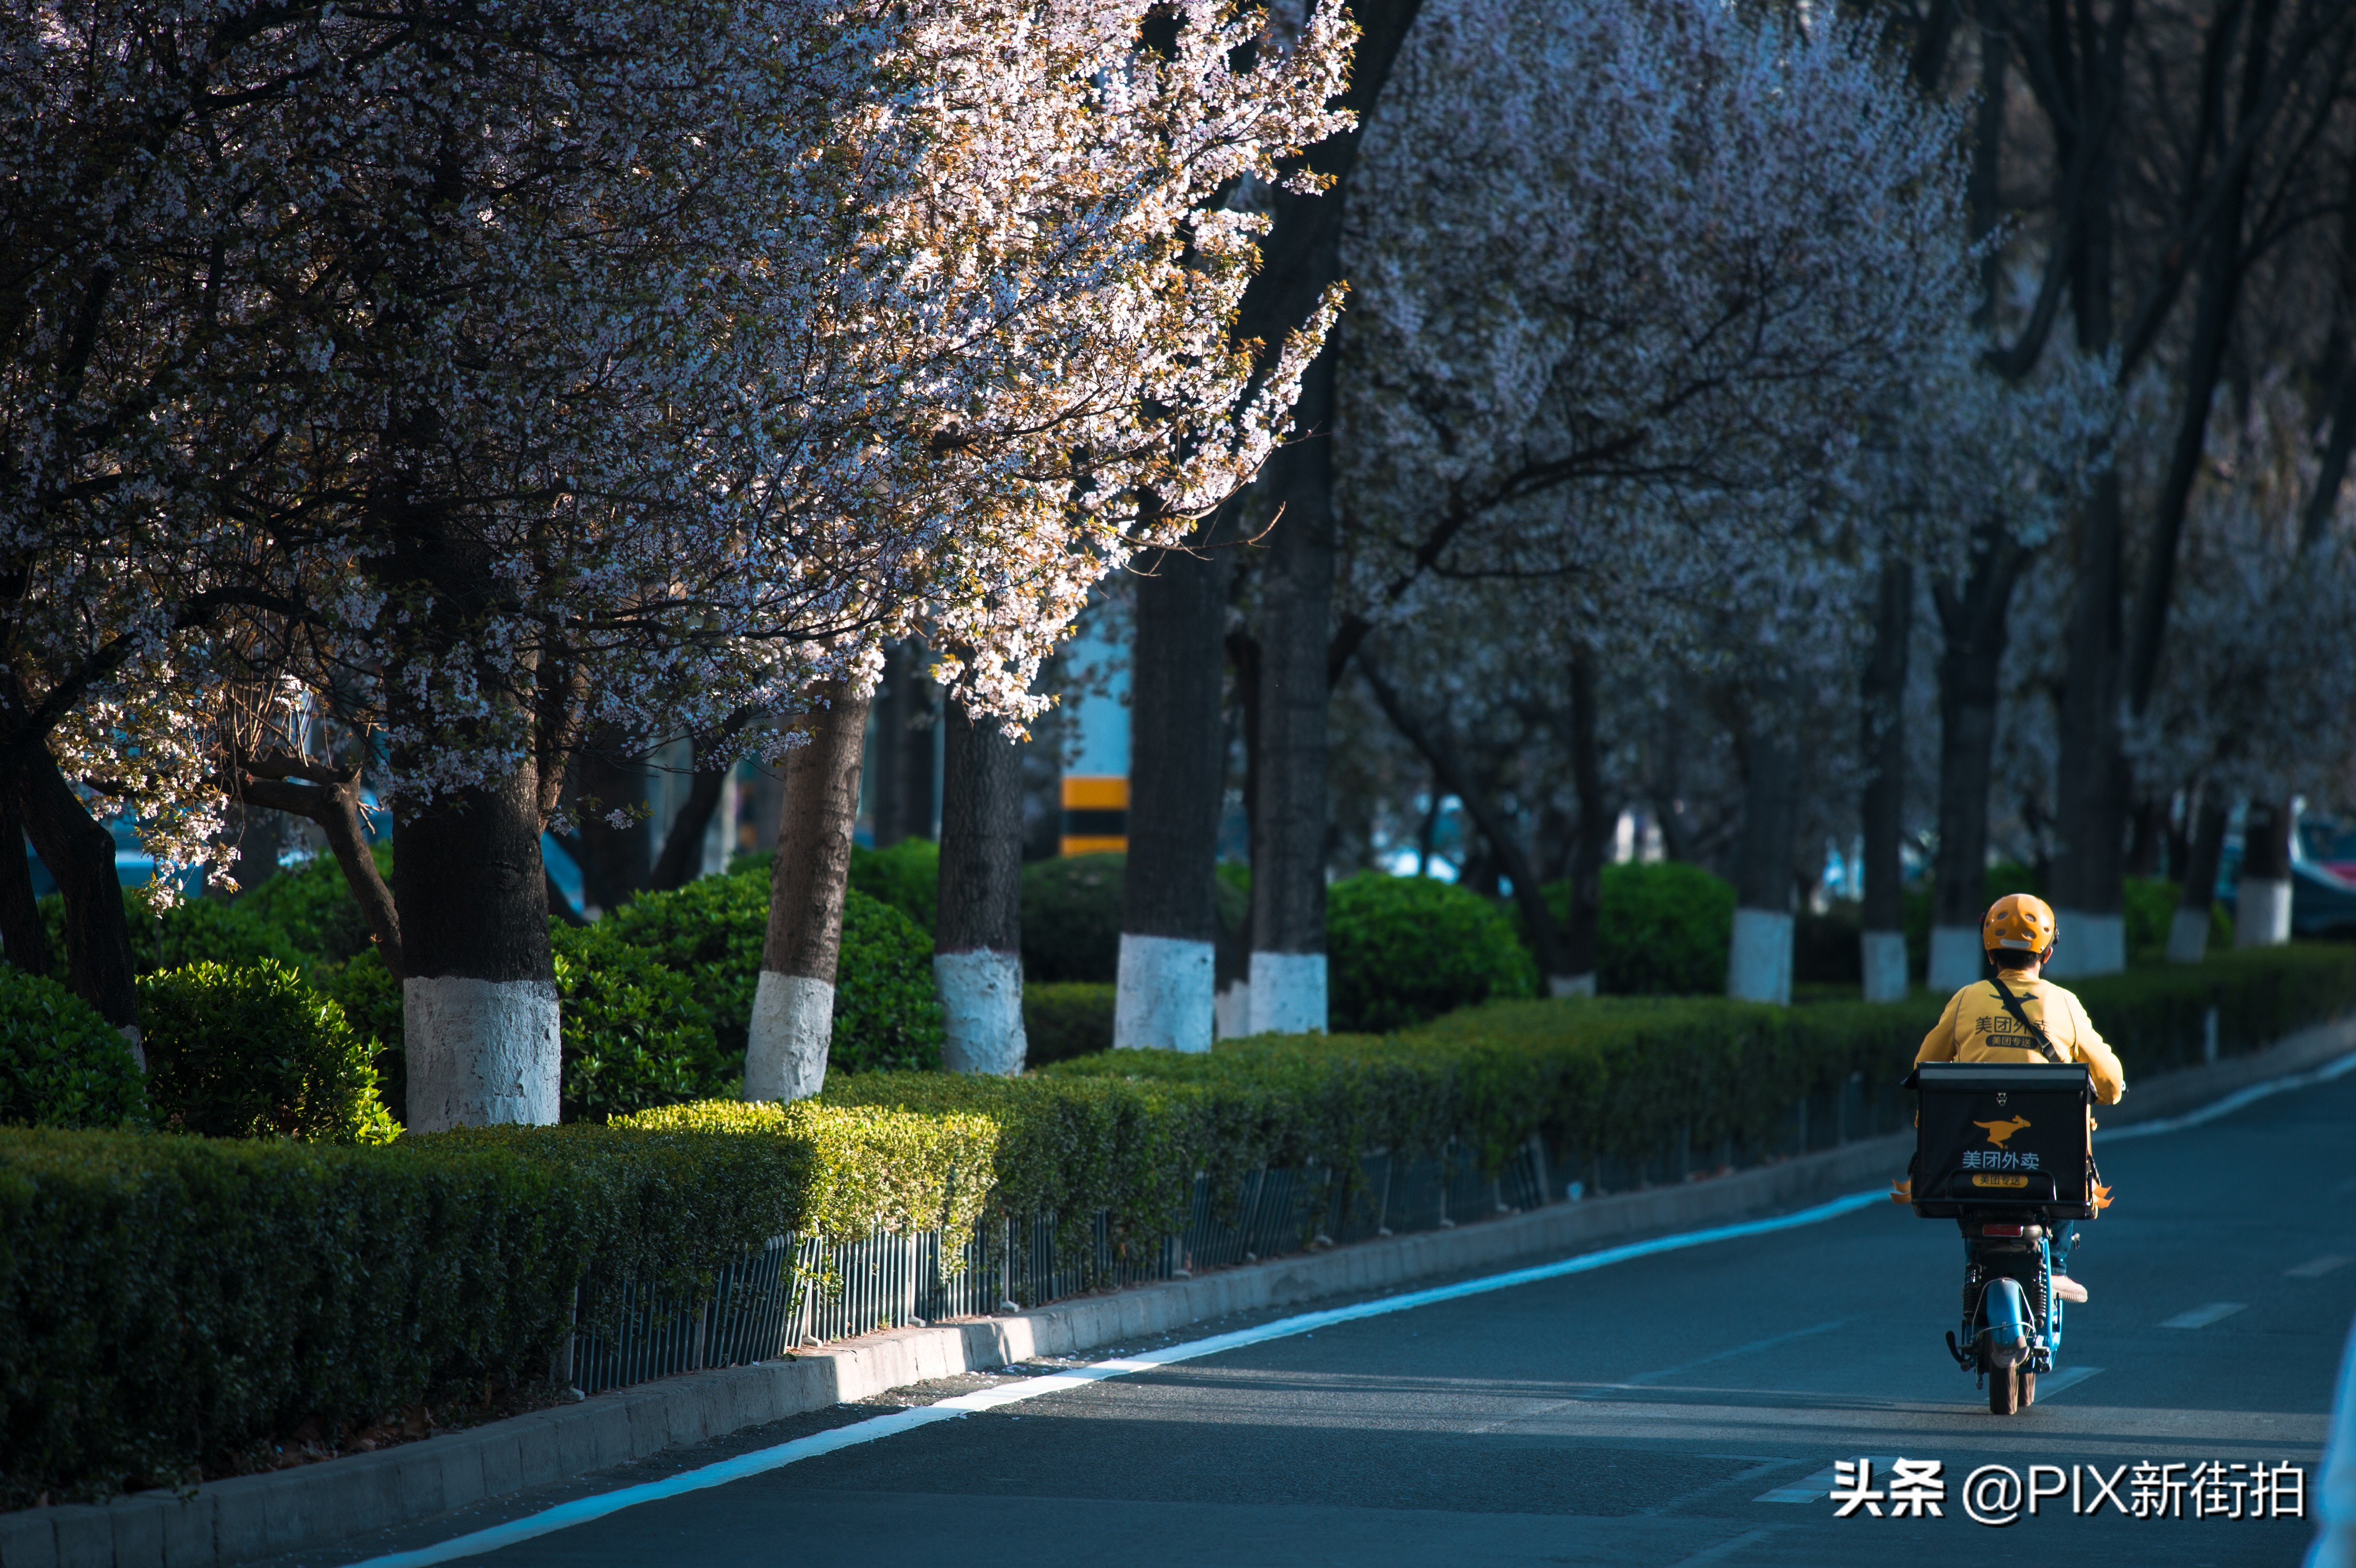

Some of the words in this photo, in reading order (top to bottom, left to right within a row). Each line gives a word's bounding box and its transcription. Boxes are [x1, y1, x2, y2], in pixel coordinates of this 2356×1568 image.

[1991, 1036, 2031, 1048] 美团专送
[1963, 1150, 2039, 1170] 美团外卖
[1980, 1175, 2020, 1186] 美团专送
